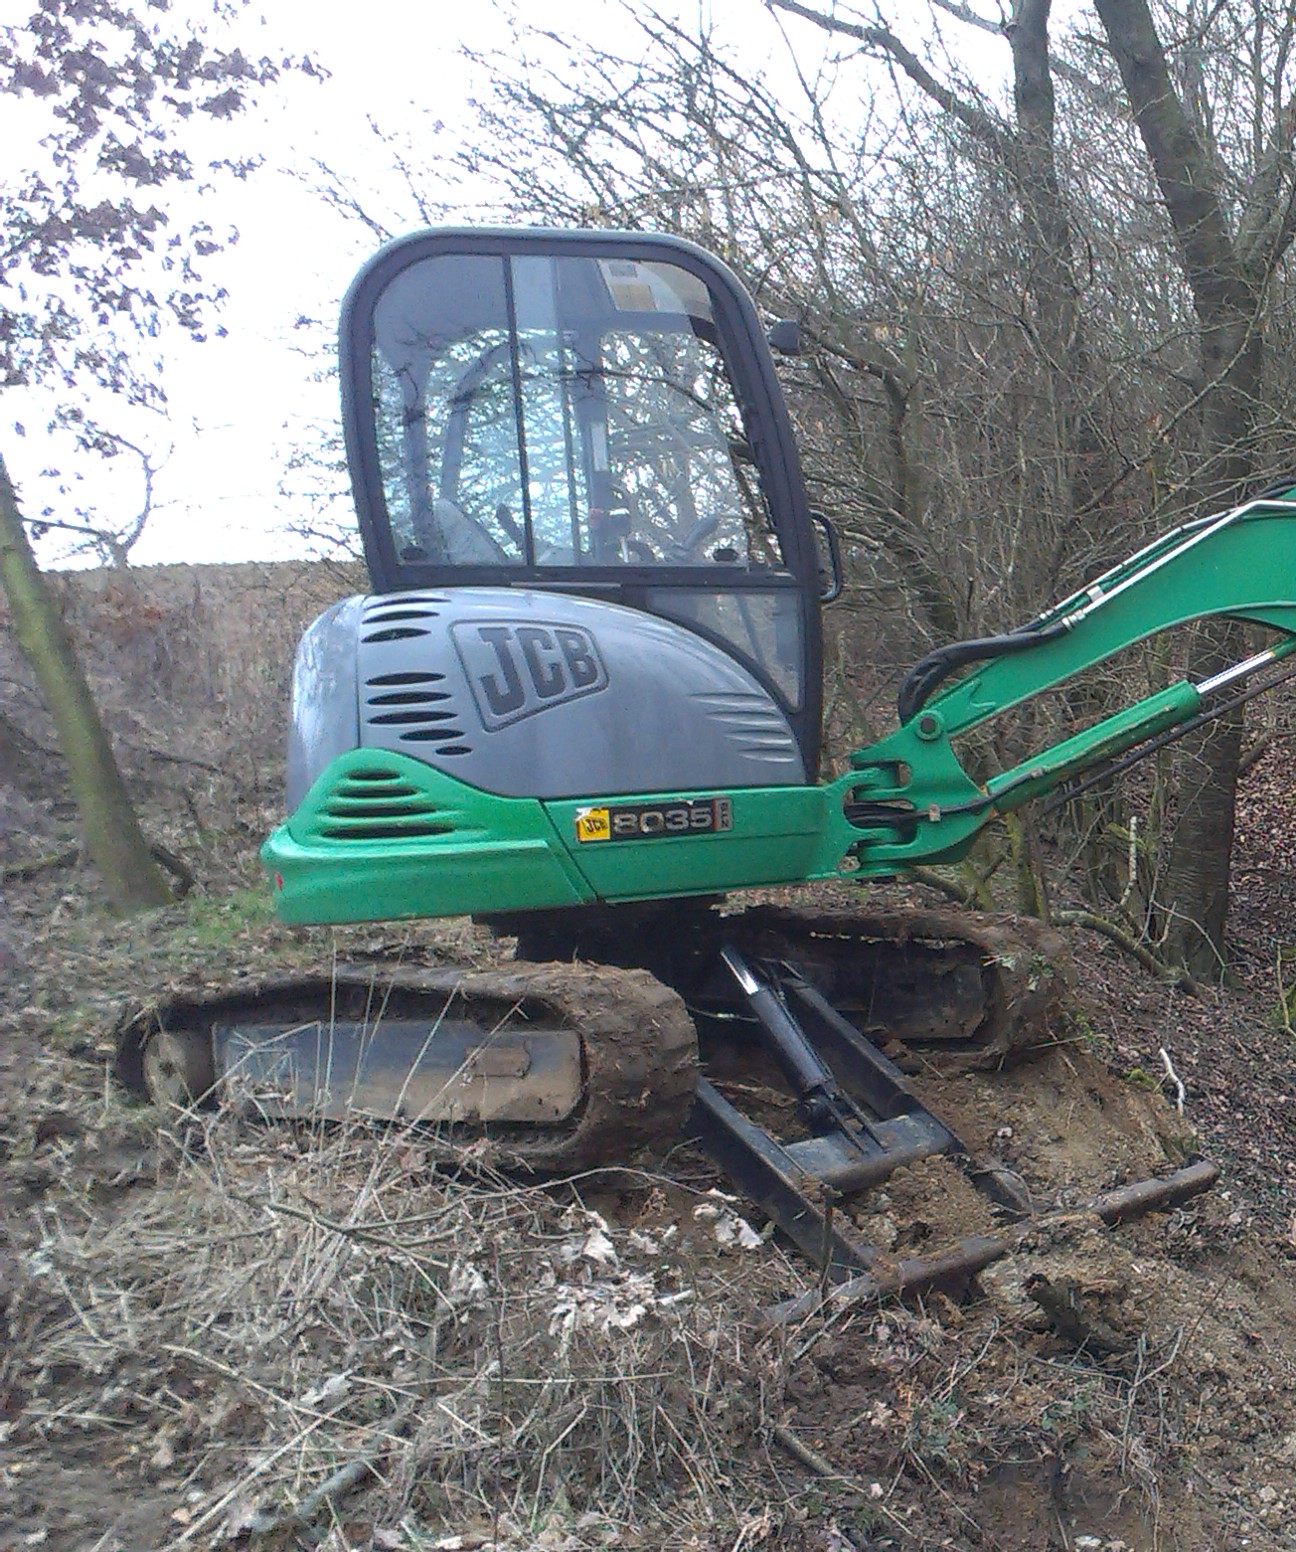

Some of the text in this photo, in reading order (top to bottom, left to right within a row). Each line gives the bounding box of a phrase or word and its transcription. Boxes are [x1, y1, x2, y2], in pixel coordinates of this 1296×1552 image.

[477, 627, 599, 716] JCB
[585, 818, 607, 833] JCB
[613, 806, 712, 834] 8035
